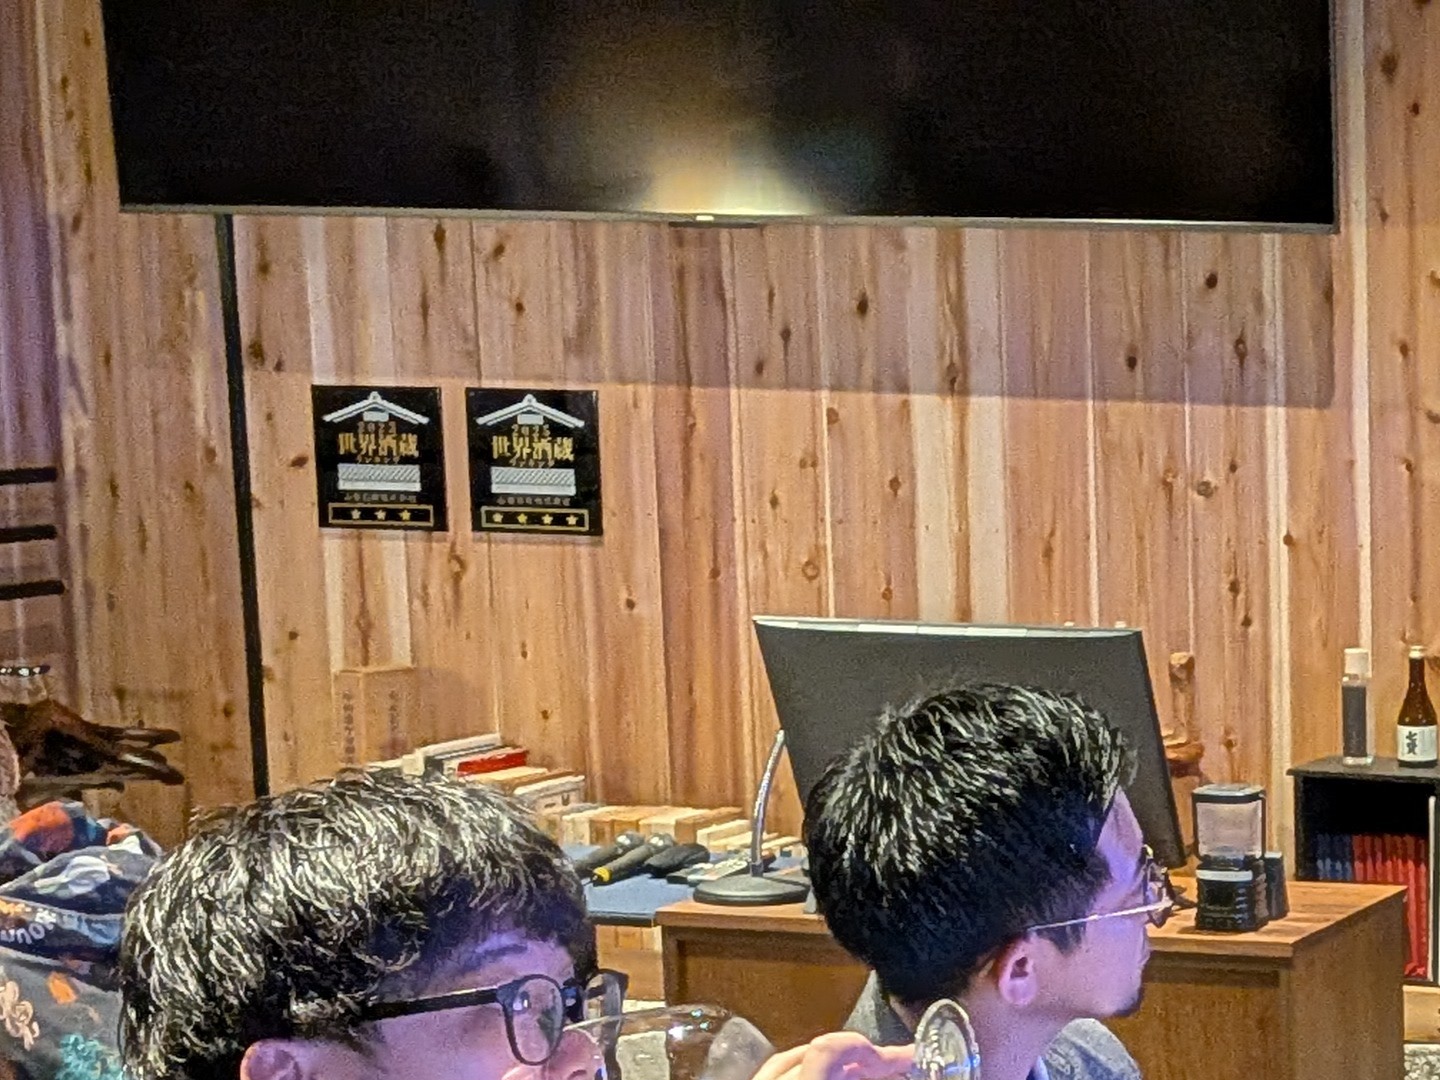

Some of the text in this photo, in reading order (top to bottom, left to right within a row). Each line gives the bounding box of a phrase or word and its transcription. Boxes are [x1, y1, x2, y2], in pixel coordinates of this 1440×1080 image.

[337, 432, 419, 457] 世界酒蔵
[491, 435, 575, 462] 世界酒蔵
